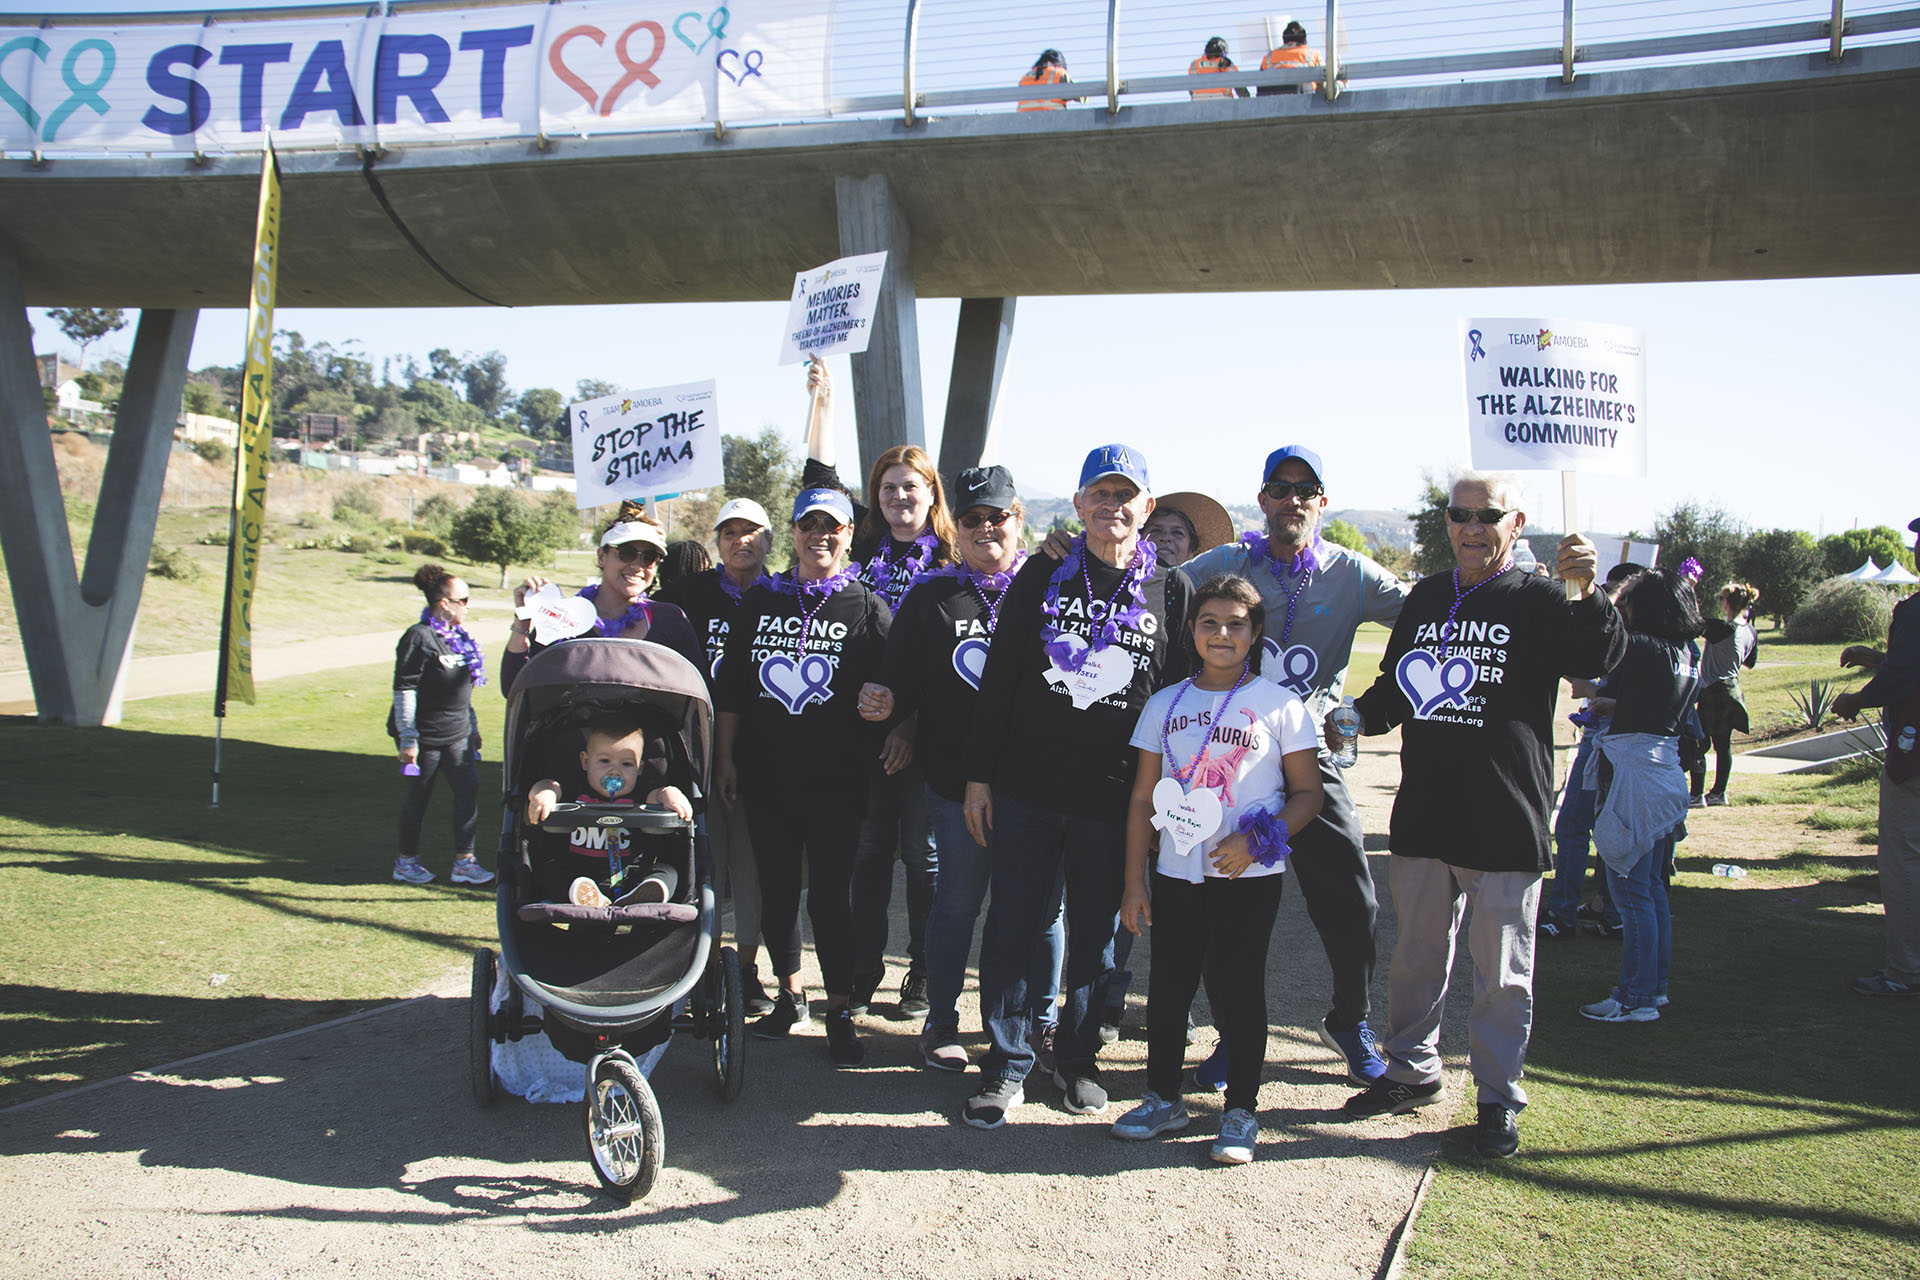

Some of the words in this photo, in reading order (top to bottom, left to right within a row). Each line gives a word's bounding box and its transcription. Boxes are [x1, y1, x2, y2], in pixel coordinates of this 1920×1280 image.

[142, 24, 535, 136] START
[806, 282, 861, 309] MEMORIES
[806, 301, 850, 326] MATTER.
[791, 331, 802, 342] THE
[801, 328, 813, 340] END
[812, 325, 821, 336] OF
[821, 318, 866, 335] ALZHEIMER'S
[799, 337, 820, 351] STARTS
[819, 334, 836, 346] WITH
[837, 332, 849, 343] ME
[1508, 333, 1536, 345] TEAM
[1553, 335, 1589, 349] AMOEBA
[1499, 366, 1586, 390] WALKING
[1590, 371, 1618, 394] FOR
[602, 404, 620, 416] TEAM
[632, 397, 663, 409] AMOEBA
[1477, 394, 1518, 416] THE
[1523, 394, 1636, 424] ALZHEIMER'S
[592, 422, 653, 463] STOP
[657, 409, 705, 439] THE
[1504, 422, 1618, 448] COMMUNITY
[605, 440, 694, 487] STIGMA
[757, 614, 849, 641] FACNG
[1414, 621, 1510, 645] FACING
[1211, 726, 1261, 751] AURUS
[600, 816, 622, 824] GRACO
[570, 826, 631, 850] DMC
